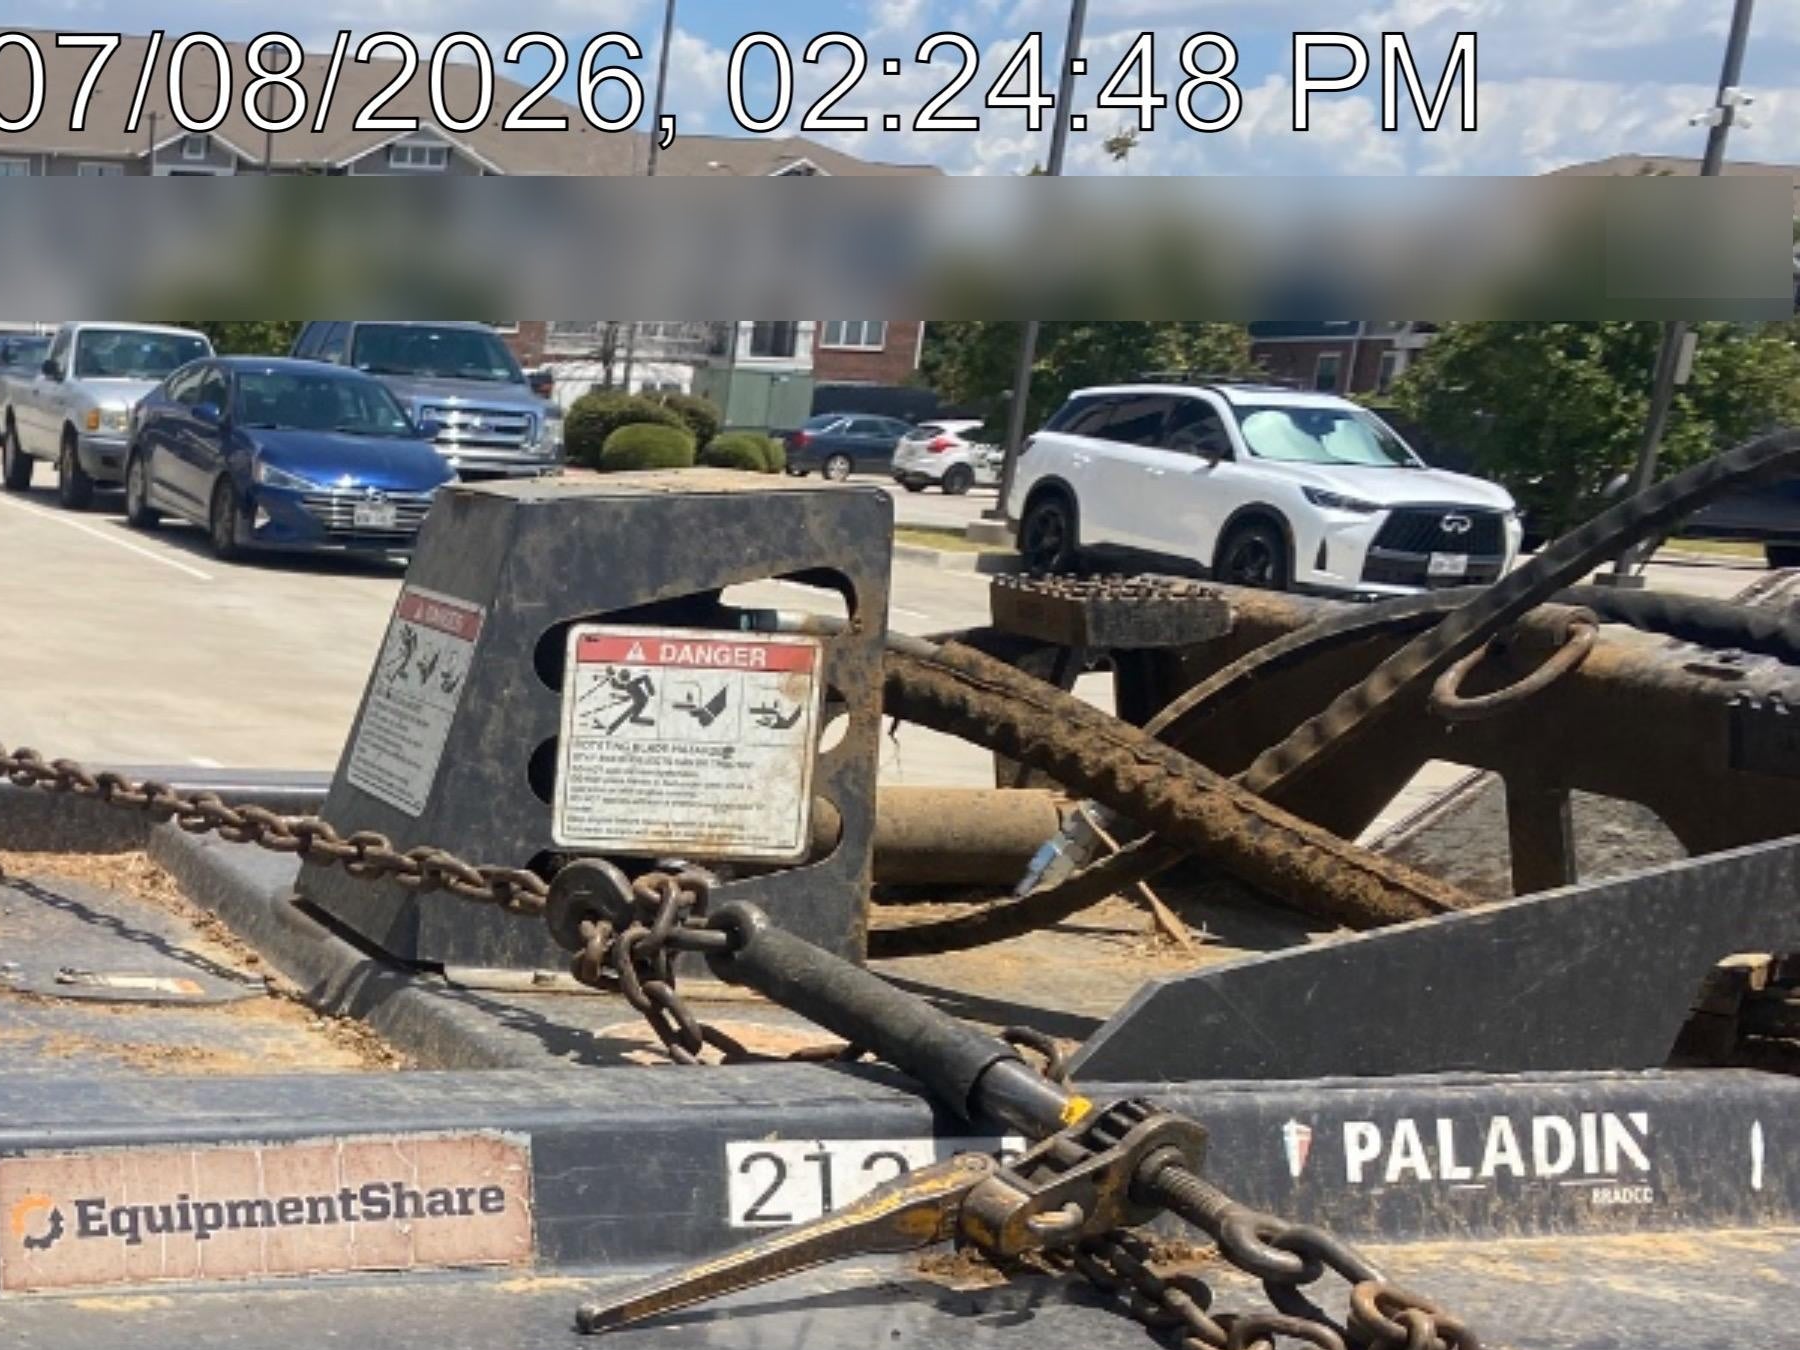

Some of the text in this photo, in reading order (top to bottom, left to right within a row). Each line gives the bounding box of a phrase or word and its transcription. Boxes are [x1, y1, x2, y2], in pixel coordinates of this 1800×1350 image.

[659, 643, 767, 667] DANGER
[1342, 1111, 1650, 1183] PALADIN
[74, 1182, 506, 1246] EquipmentShare
